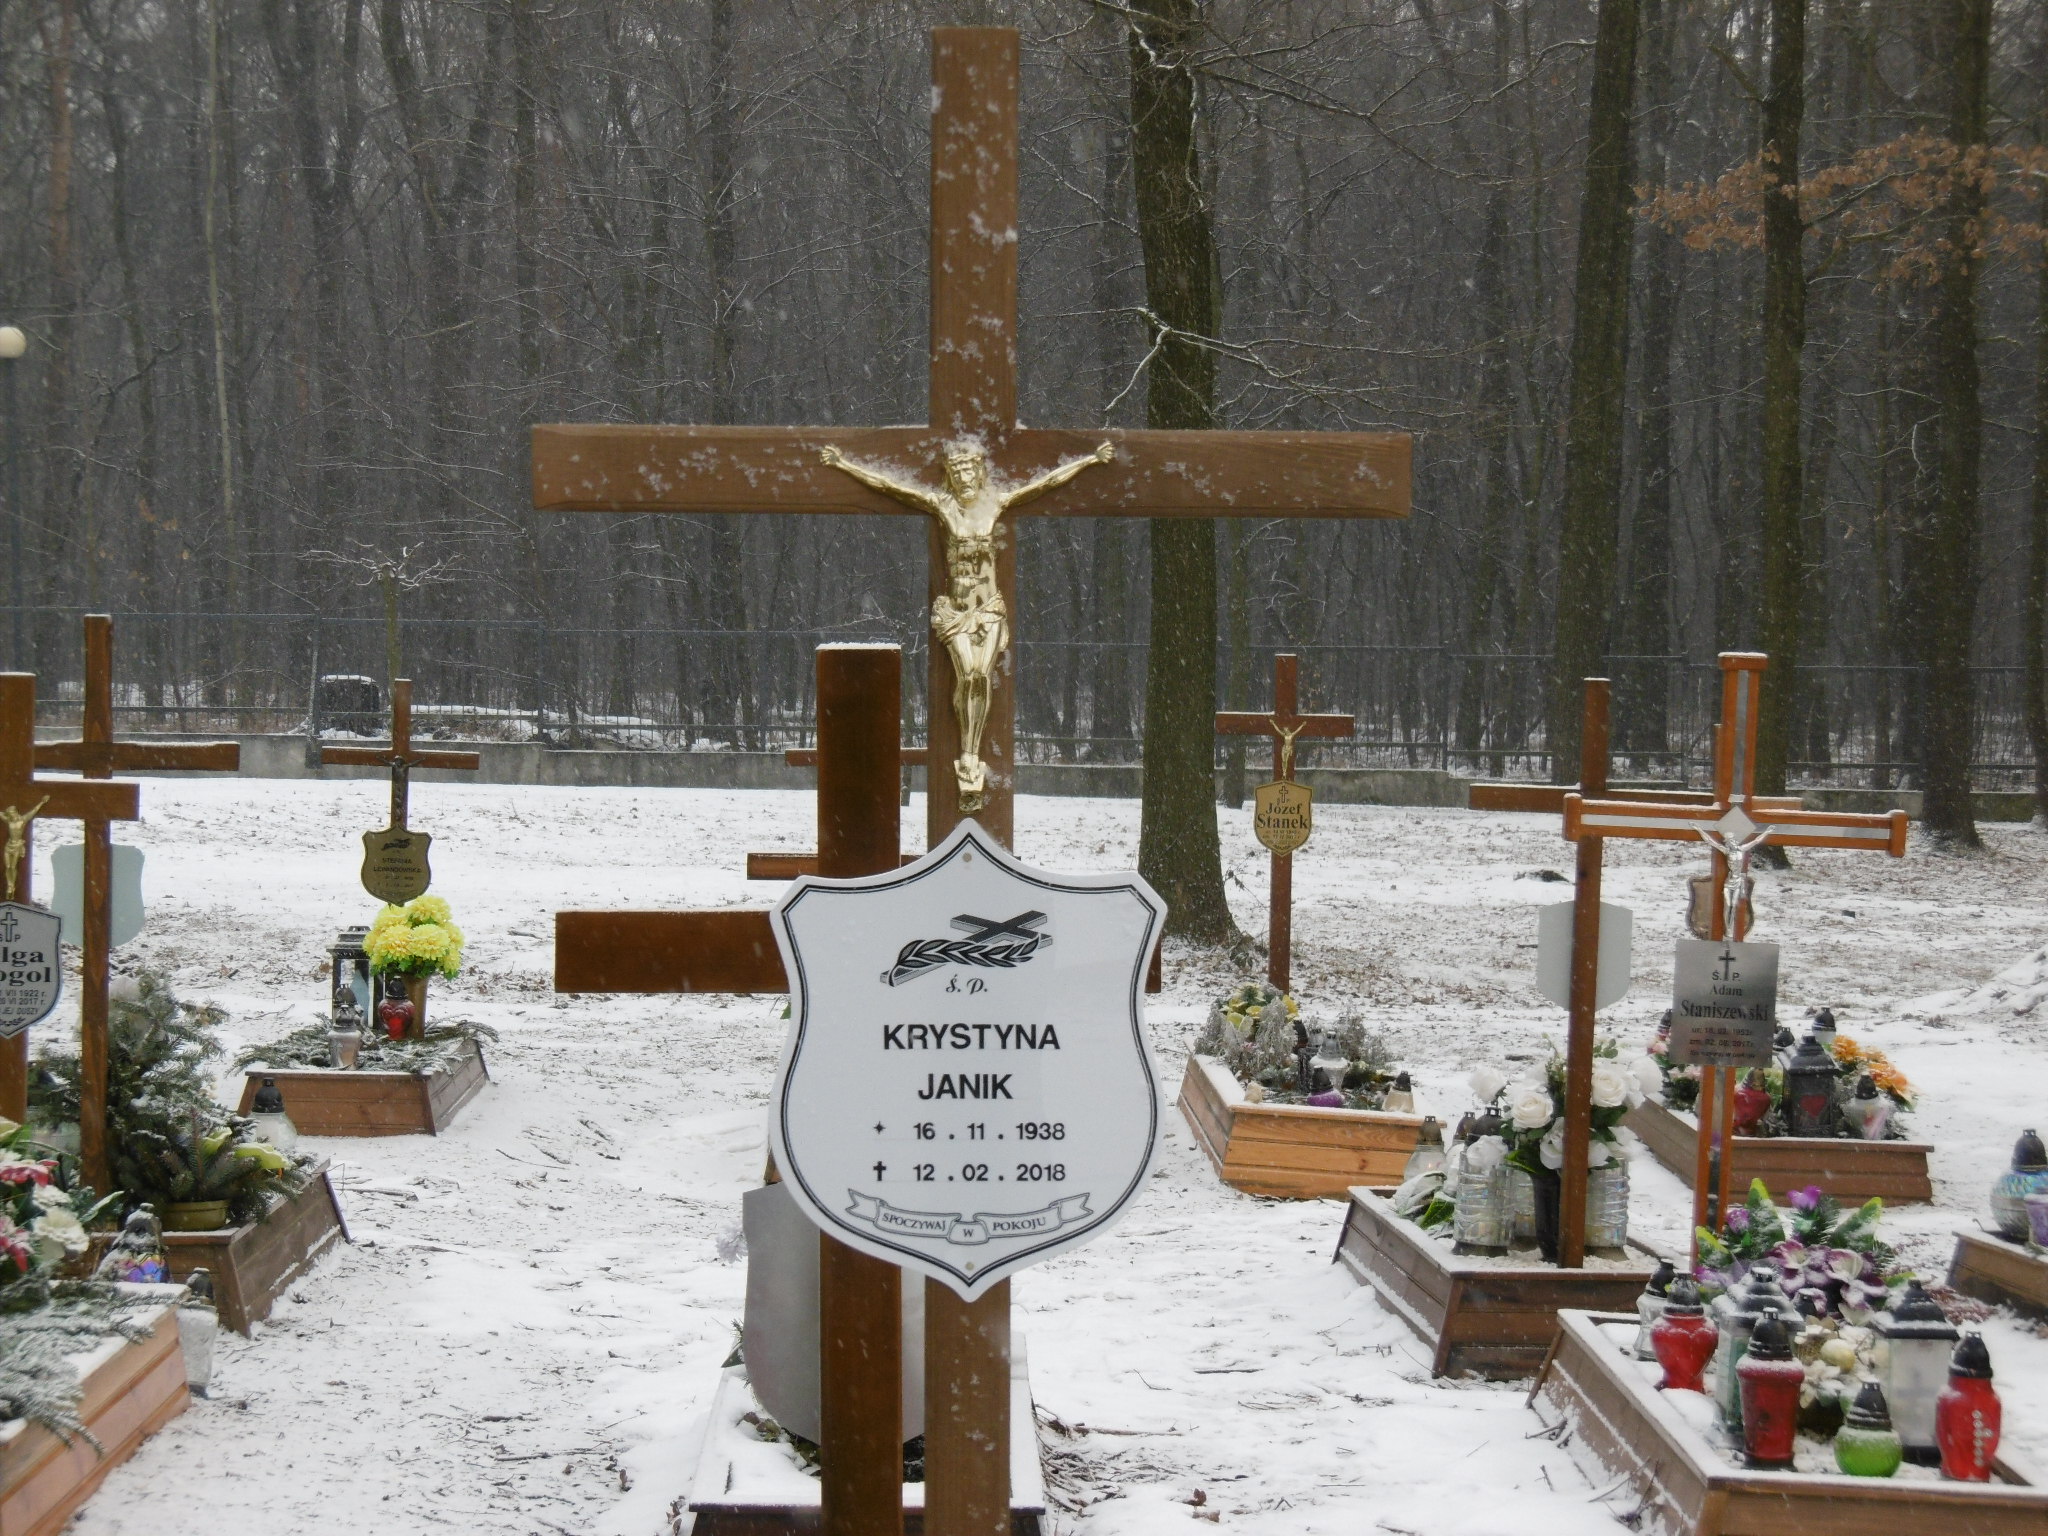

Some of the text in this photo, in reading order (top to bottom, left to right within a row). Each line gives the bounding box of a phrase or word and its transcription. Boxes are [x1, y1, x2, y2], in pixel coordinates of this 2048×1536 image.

[1265, 803, 1302, 815] Józef
[1257, 814, 1308, 829] Stanek
[0, 946, 44, 967] lga
[1709, 984, 1743, 996] Adam
[1680, 999, 1769, 1021] Staniszewski
[883, 1023, 1060, 1050] KRYSTYNA
[918, 1073, 1013, 1100] JANIK
[882, 1212, 947, 1232] SPOCZYWAJ
[992, 1216, 1047, 1231] POKOJU
